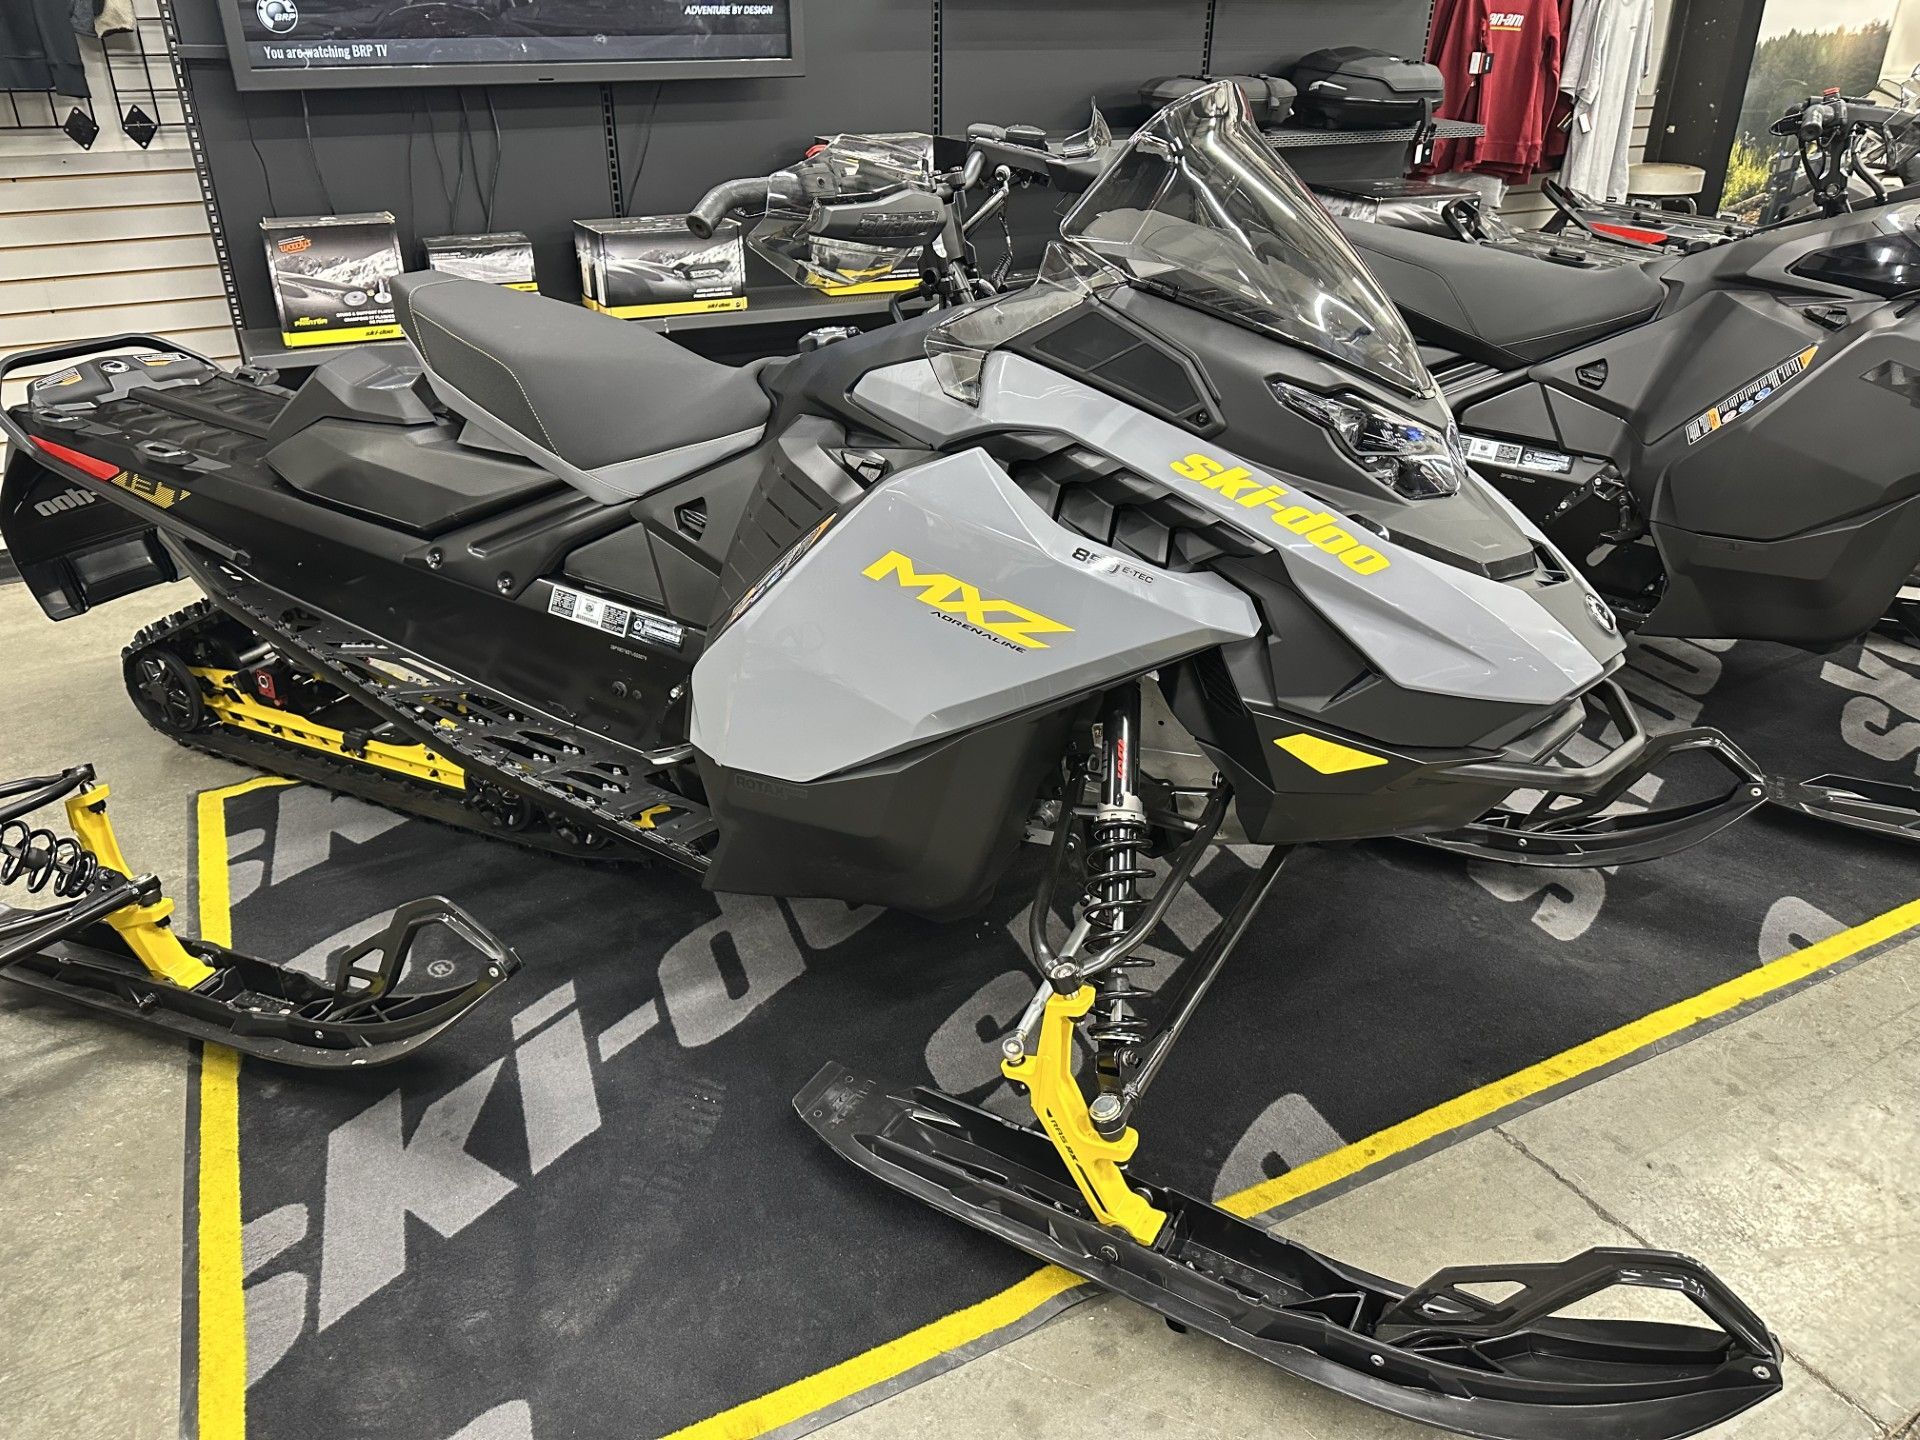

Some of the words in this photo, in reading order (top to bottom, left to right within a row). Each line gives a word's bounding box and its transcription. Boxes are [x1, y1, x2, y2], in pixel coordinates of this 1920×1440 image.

[274, 12, 296, 22] BRP
[684, 5, 731, 15] ADVENTURE
[731, 5, 743, 15] BY
[743, 5, 774, 15] DESIGN
[1489, 12, 1525, 27] an-am
[263, 46, 285, 60] You
[286, 49, 304, 59] are
[304, 45, 351, 60] watching
[351, 44, 373, 58] BRP
[374, 44, 388, 57] TV
[1170, 453, 1391, 576] ski-doo
[861, 550, 1076, 649] MXZ
[930, 611, 1027, 654] ADRENALINE
